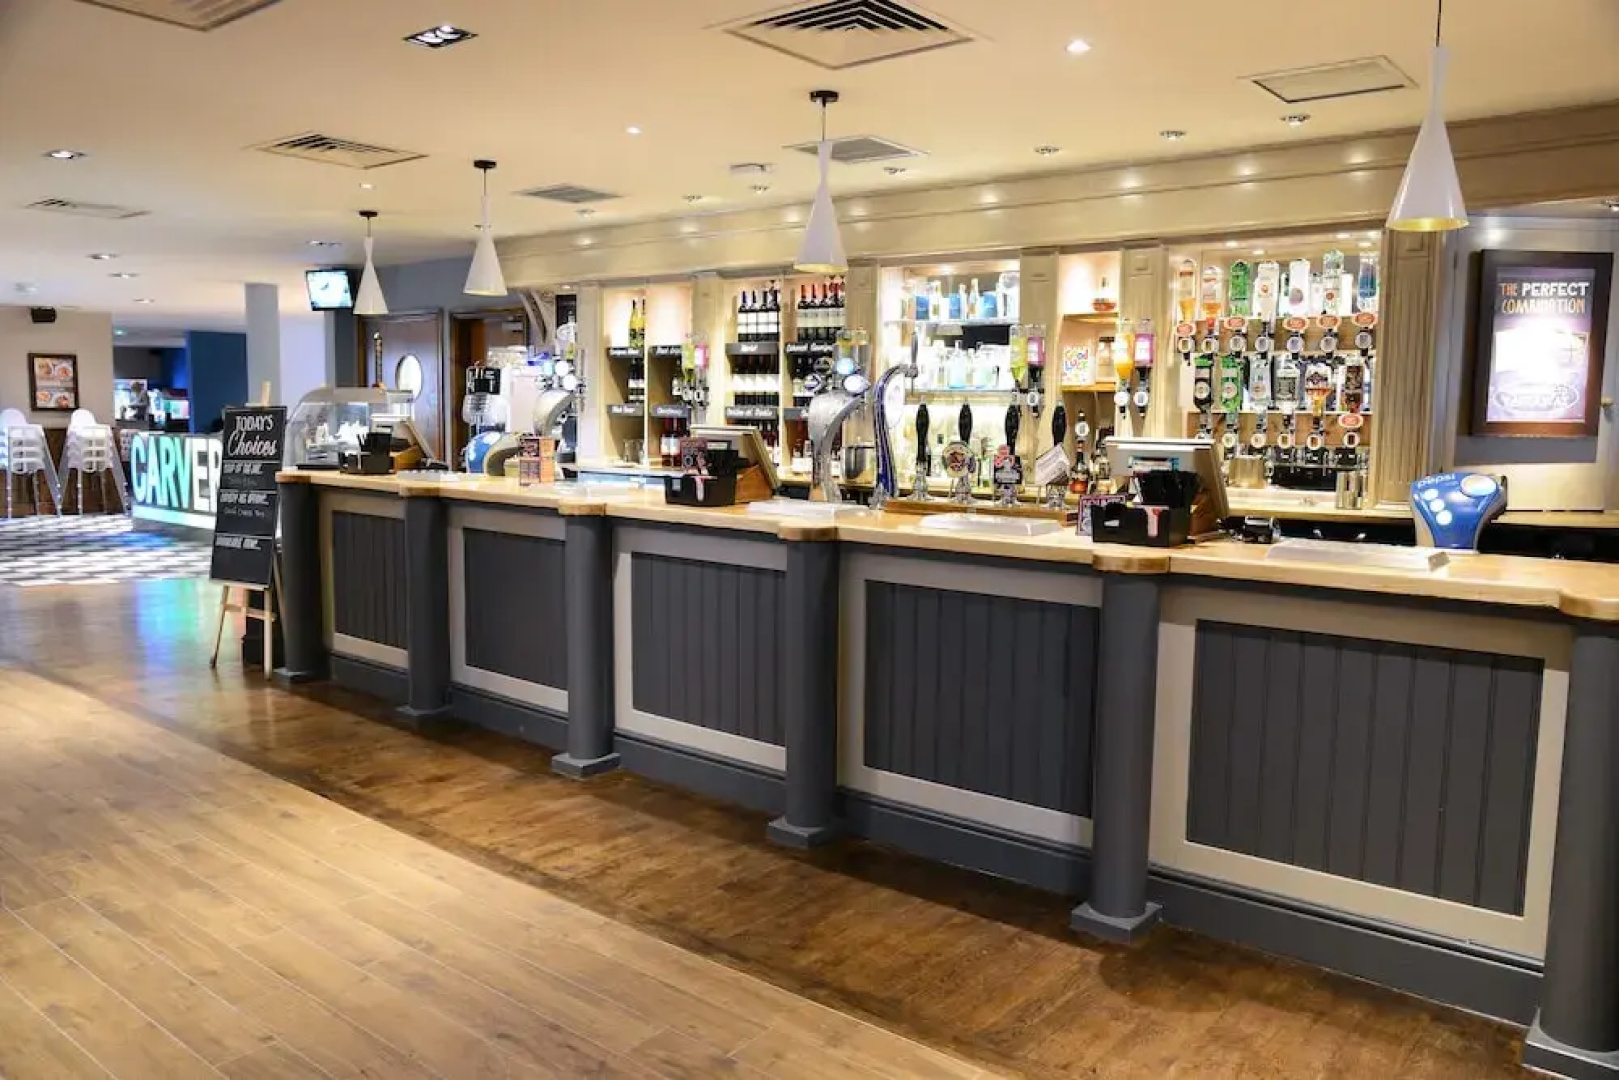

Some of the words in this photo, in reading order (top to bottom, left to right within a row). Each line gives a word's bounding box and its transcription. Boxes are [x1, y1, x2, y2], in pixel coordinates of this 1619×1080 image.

[1500, 282, 1518, 296] THE
[1521, 281, 1590, 297] PERFECT
[235, 414, 274, 432] TODAY'S
[228, 430, 277, 457] Choices
